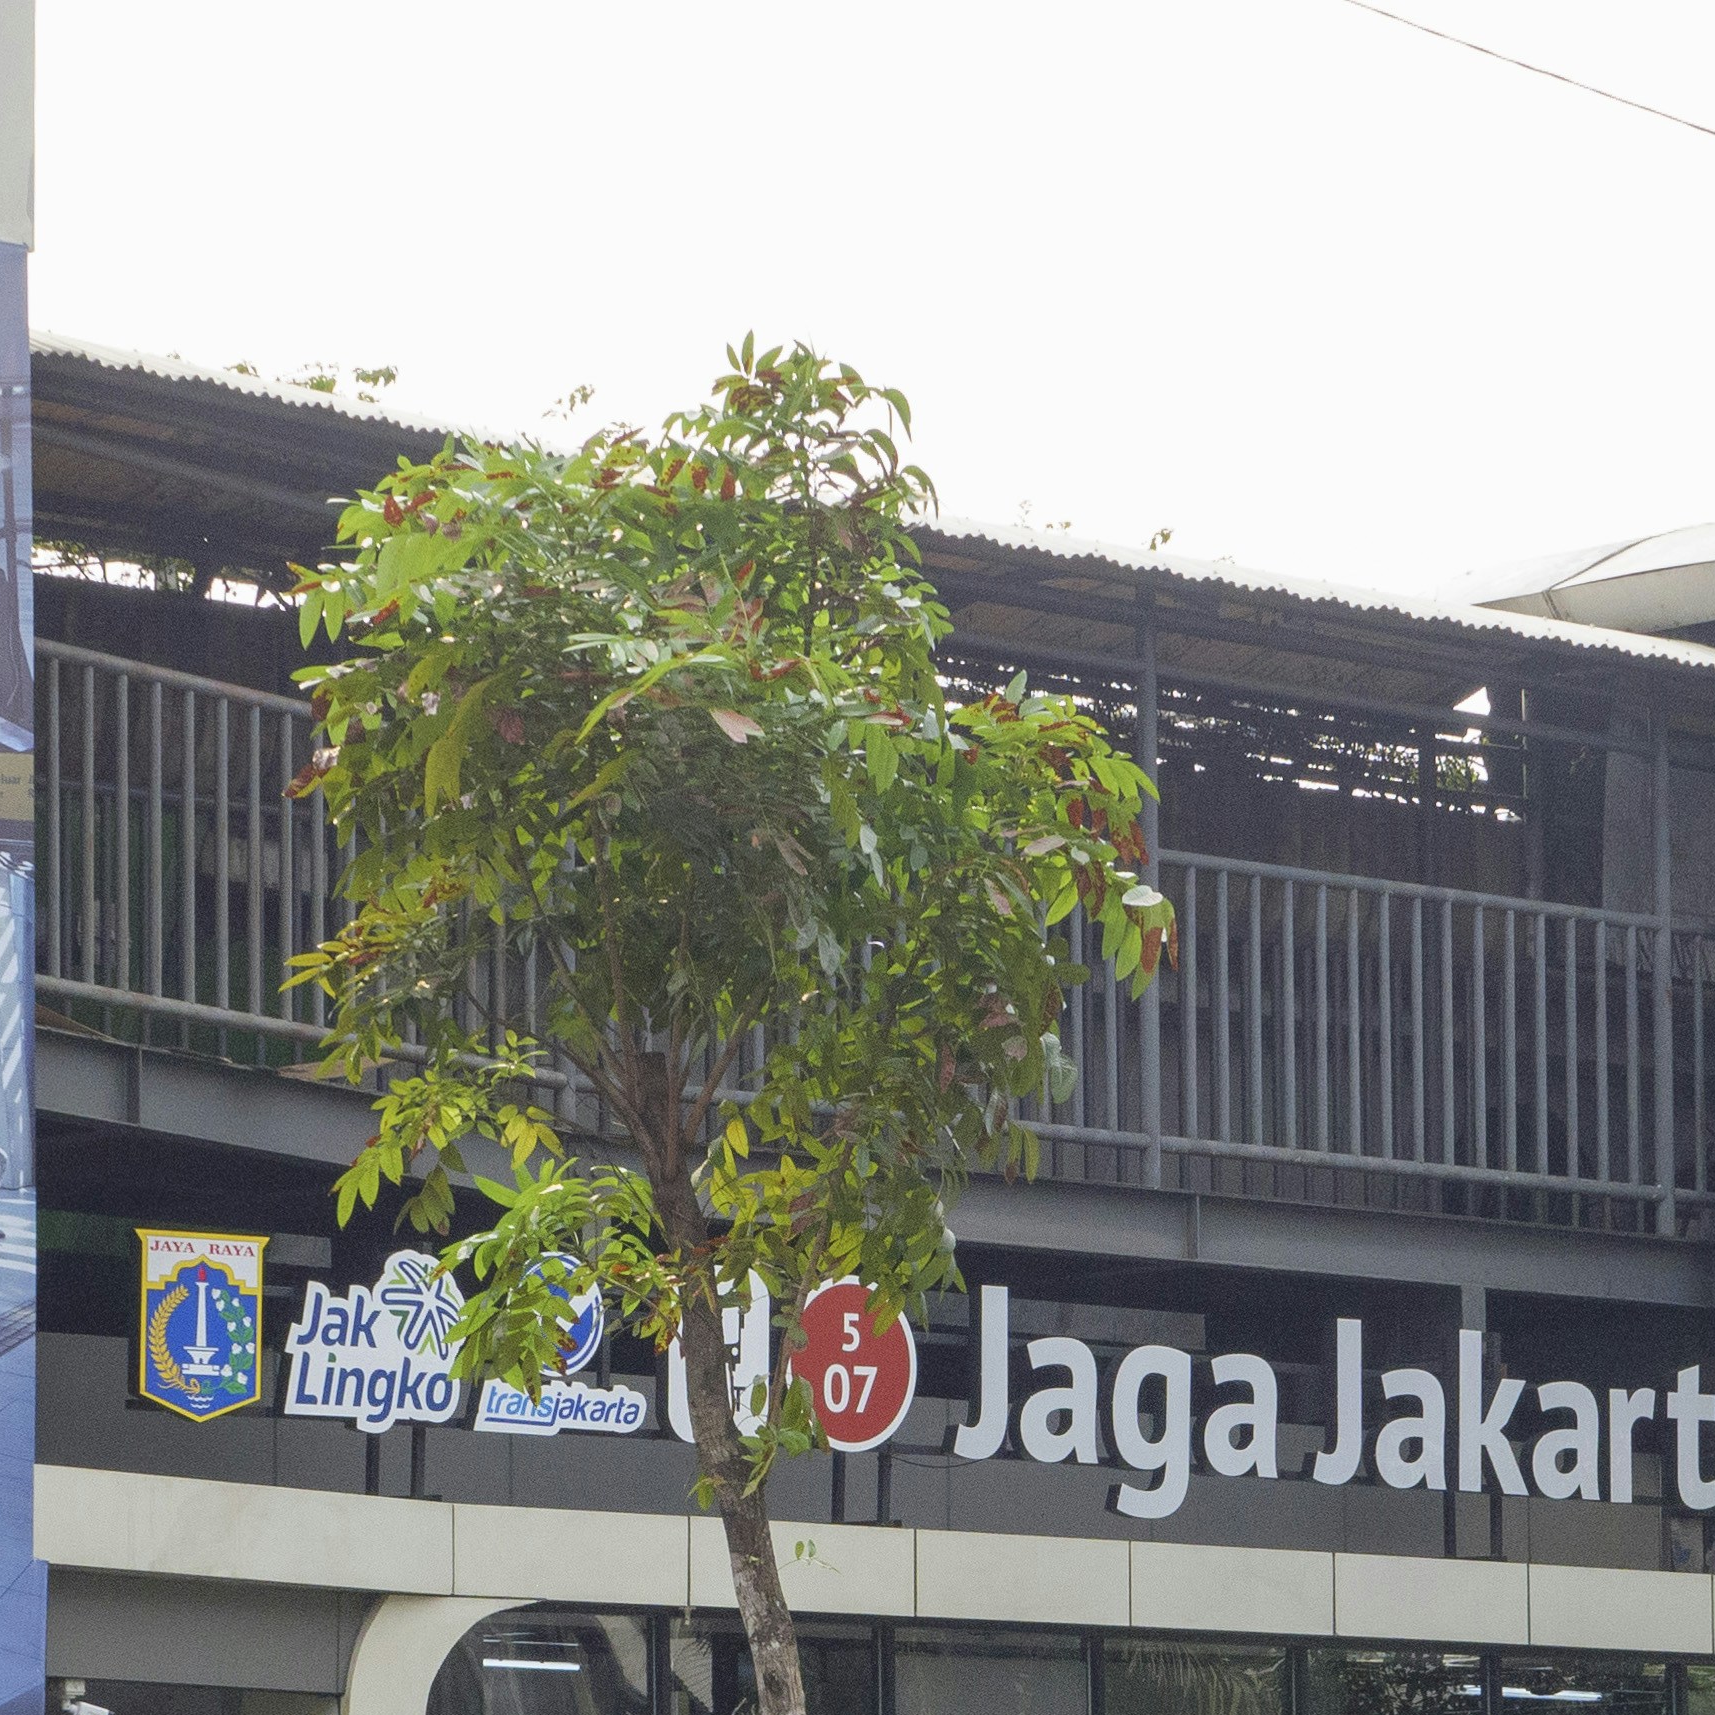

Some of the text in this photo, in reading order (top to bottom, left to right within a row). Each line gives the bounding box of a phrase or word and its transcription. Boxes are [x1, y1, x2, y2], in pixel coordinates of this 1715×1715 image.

[150, 1240, 255, 1258] JAYA RAYA
[296, 1291, 382, 1349] Jak
[841, 1312, 861, 1352] 5
[295, 1350, 454, 1424] Lingko
[823, 1363, 879, 1414] 07
[953, 1284, 1279, 1520] Jaga
